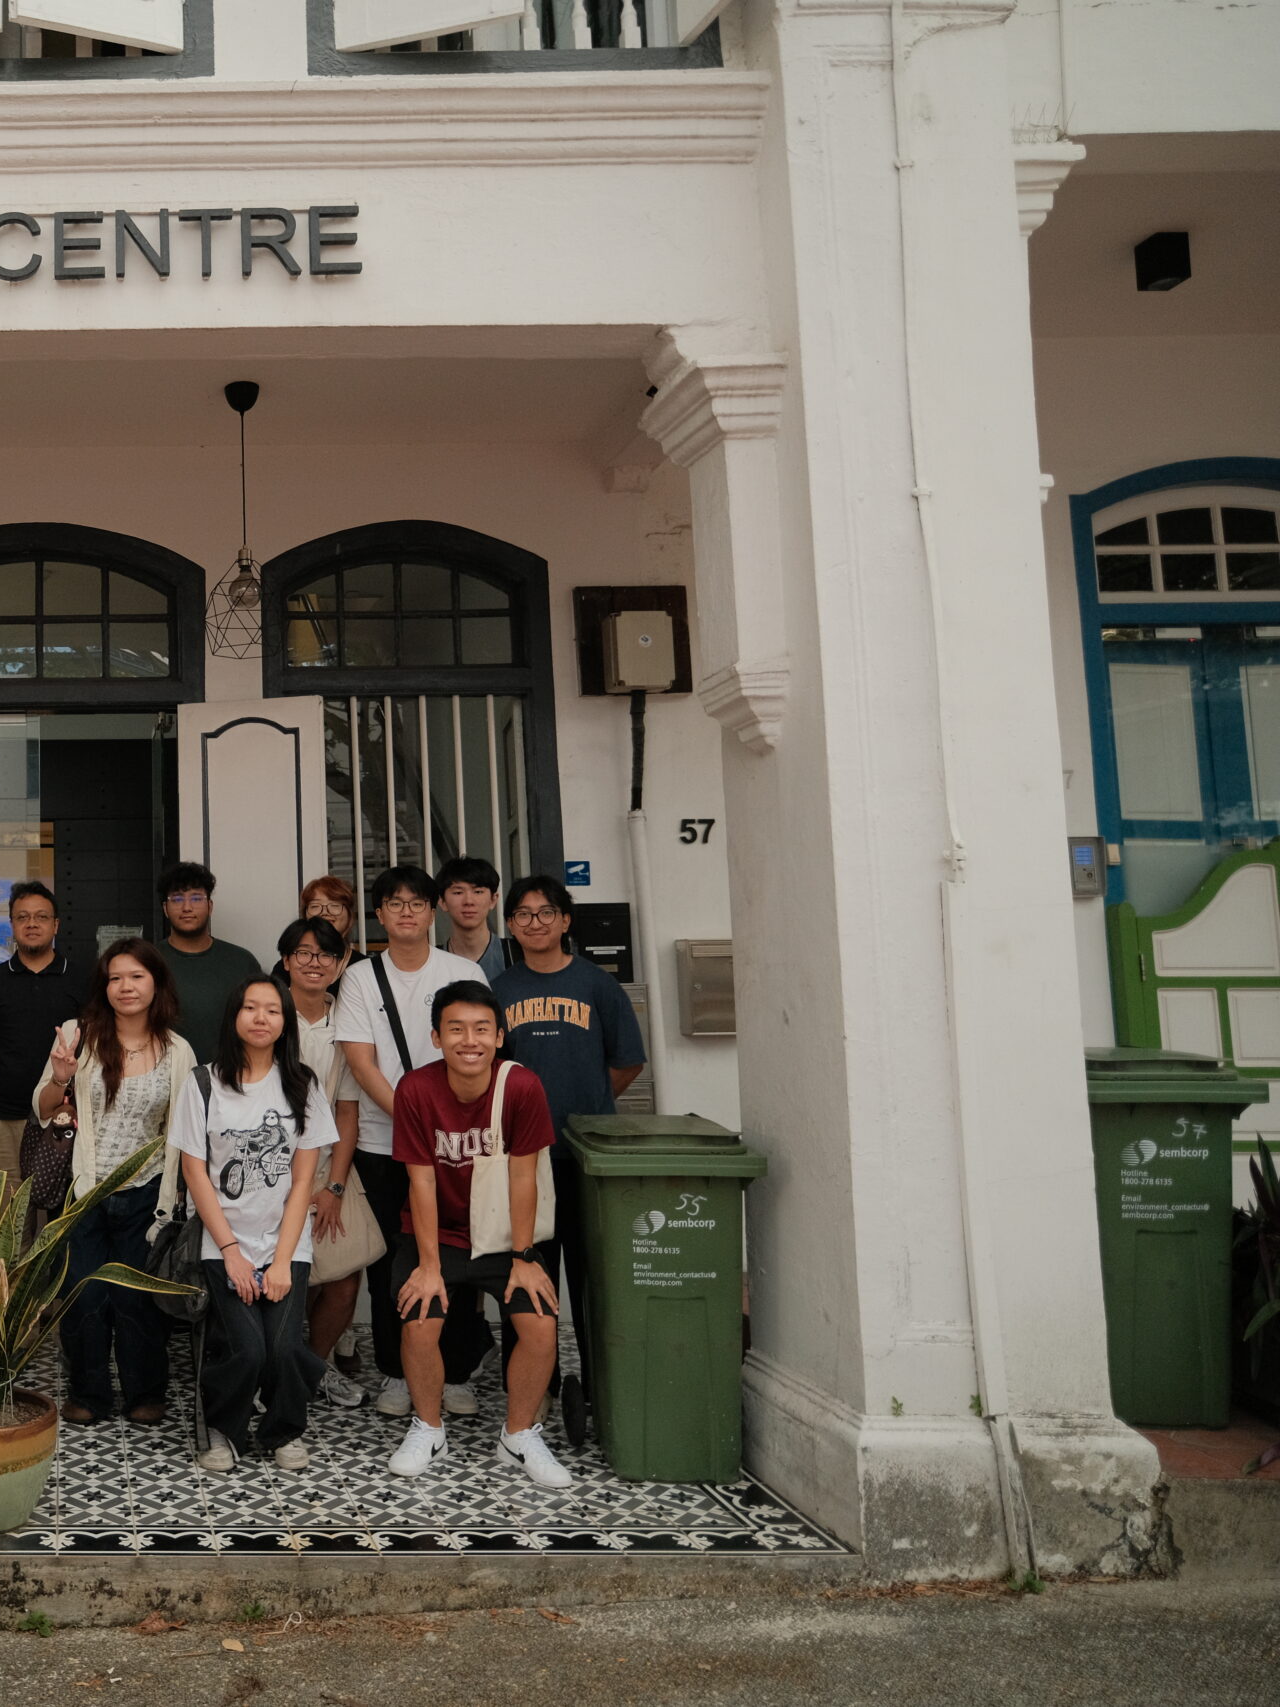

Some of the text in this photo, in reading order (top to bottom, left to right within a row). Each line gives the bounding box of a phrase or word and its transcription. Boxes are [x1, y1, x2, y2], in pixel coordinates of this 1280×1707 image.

[679, 818, 716, 845] 57
[504, 996, 591, 1033] MANHATTAN
[1171, 1117, 1208, 1140] 57
[1159, 1146, 1209, 1161] sembcorp
[1121, 1169, 1148, 1177] Hotline
[1121, 1178, 1173, 1186] 1800-278 6135
[1121, 1194, 1142, 1202] Email
[674, 1193, 708, 1216] 55
[1121, 1211, 1174, 1220] sembcorp.com
[667, 1217, 716, 1231] sembcorp
[632, 1238, 658, 1246] Hotline
[632, 1246, 680, 1254] 1800-278 6135
[633, 1262, 652, 1270] Email
[633, 1278, 683, 1287] sembcorp.com
